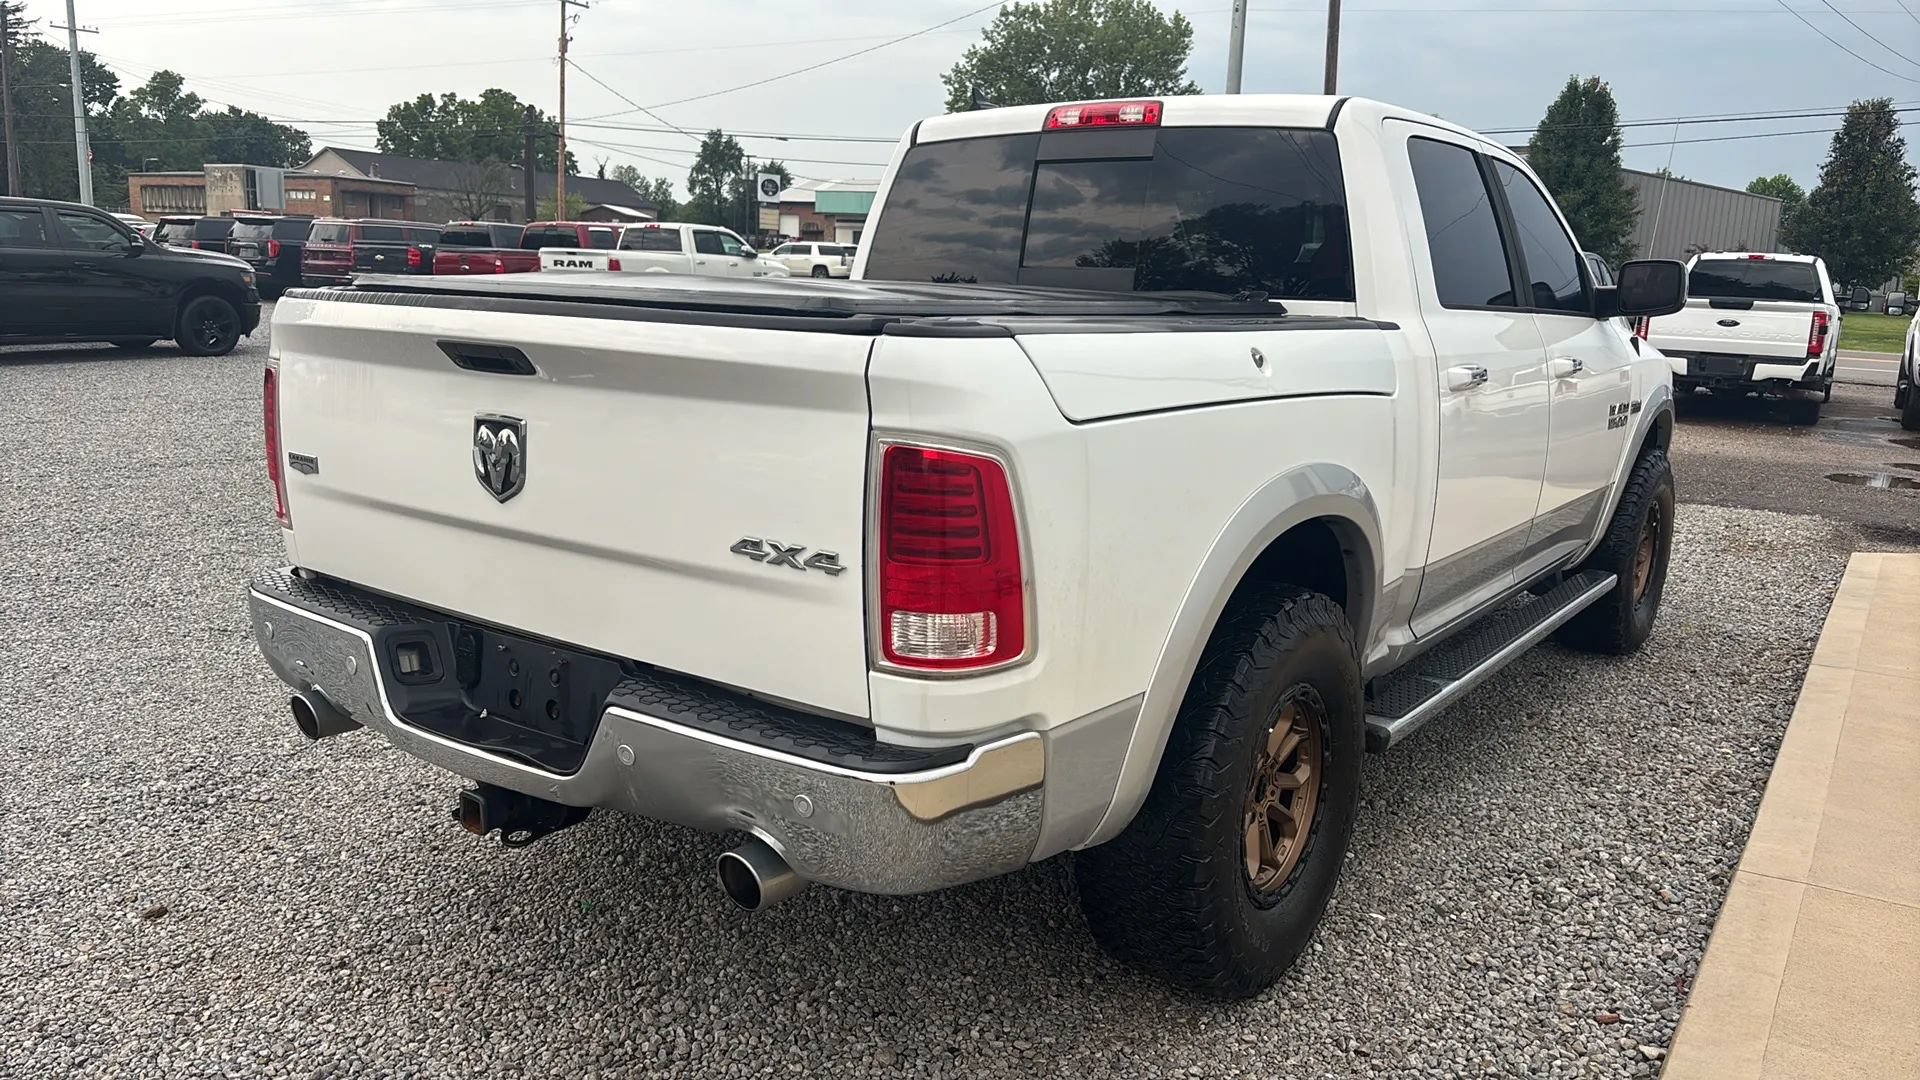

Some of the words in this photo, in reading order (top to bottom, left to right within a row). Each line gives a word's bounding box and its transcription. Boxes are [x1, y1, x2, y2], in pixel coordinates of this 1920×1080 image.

[553, 259, 593, 268] RAM
[1609, 402, 1629, 416] RAM
[730, 536, 847, 576] 4X4
